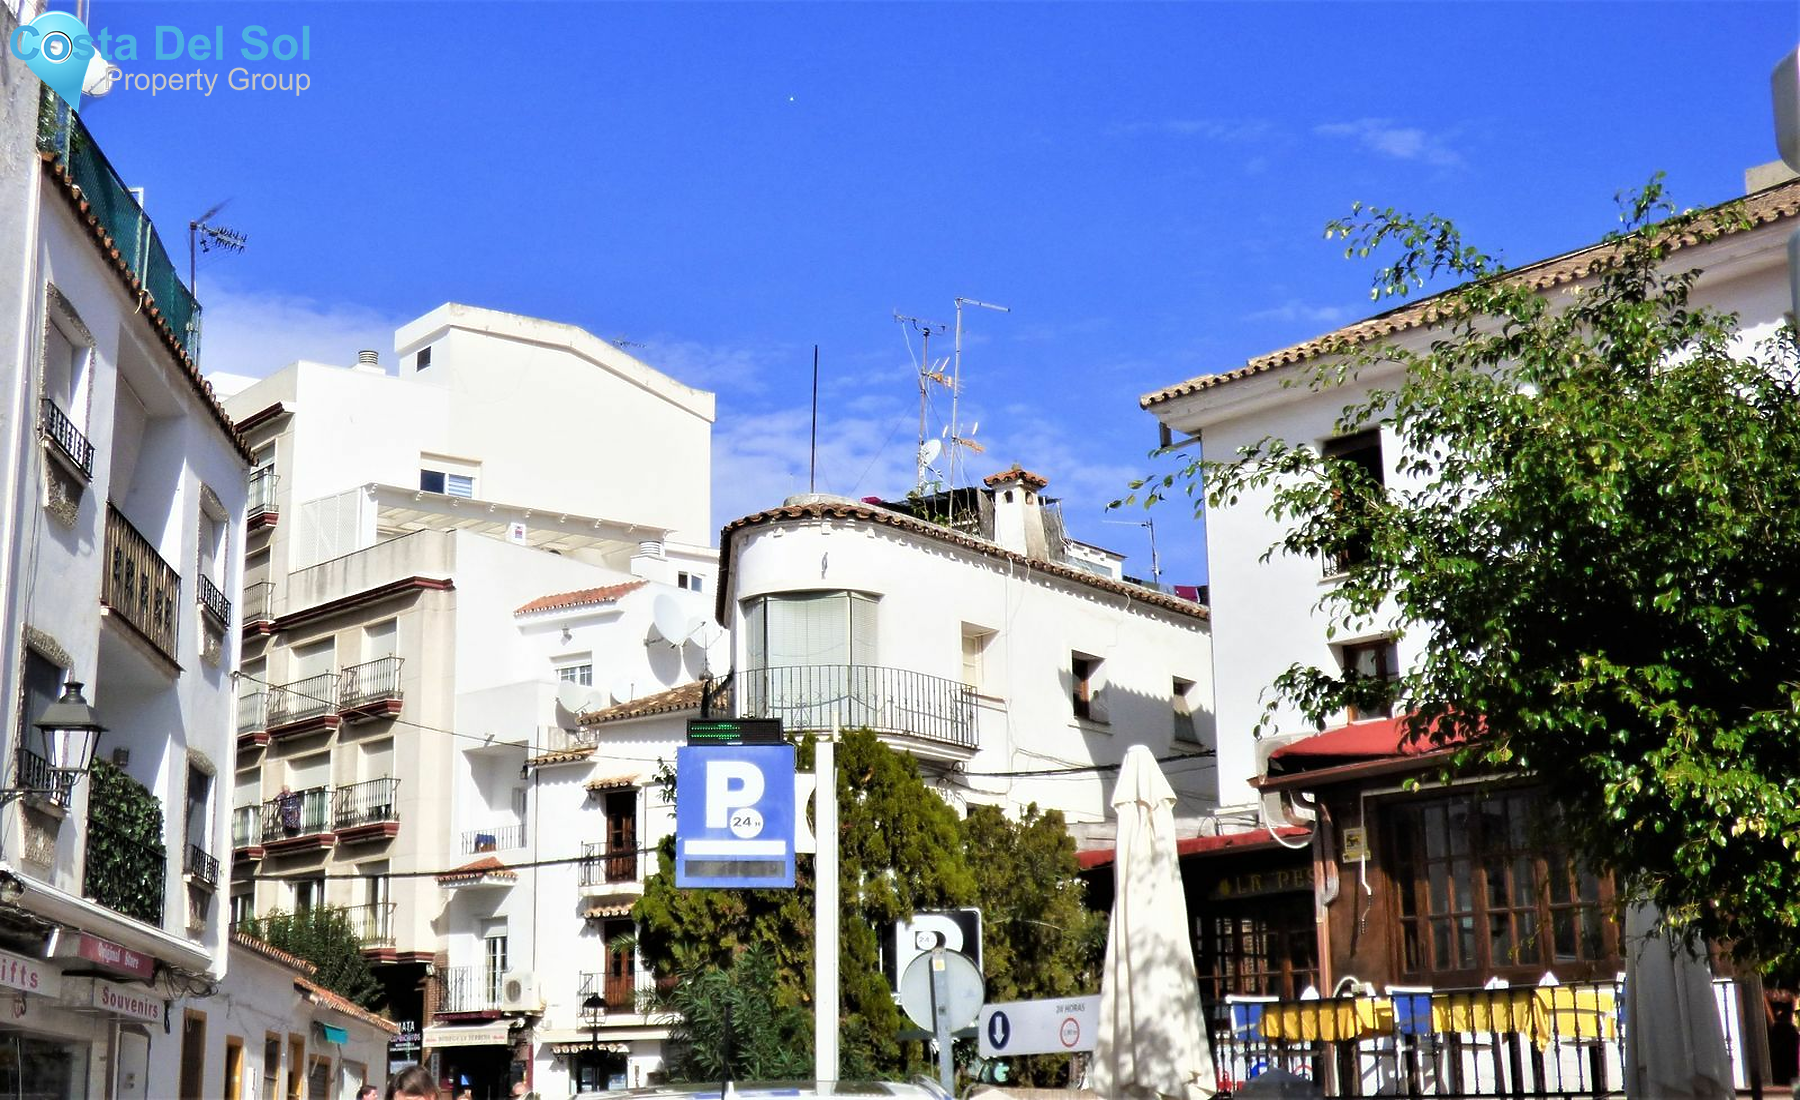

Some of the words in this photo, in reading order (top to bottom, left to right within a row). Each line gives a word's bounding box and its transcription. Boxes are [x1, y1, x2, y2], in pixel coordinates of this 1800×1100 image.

[706, 760, 765, 828] P
[733, 817, 751, 827] 24
[1, 959, 38, 988] ifts
[102, 986, 158, 1018] Souvenirs
